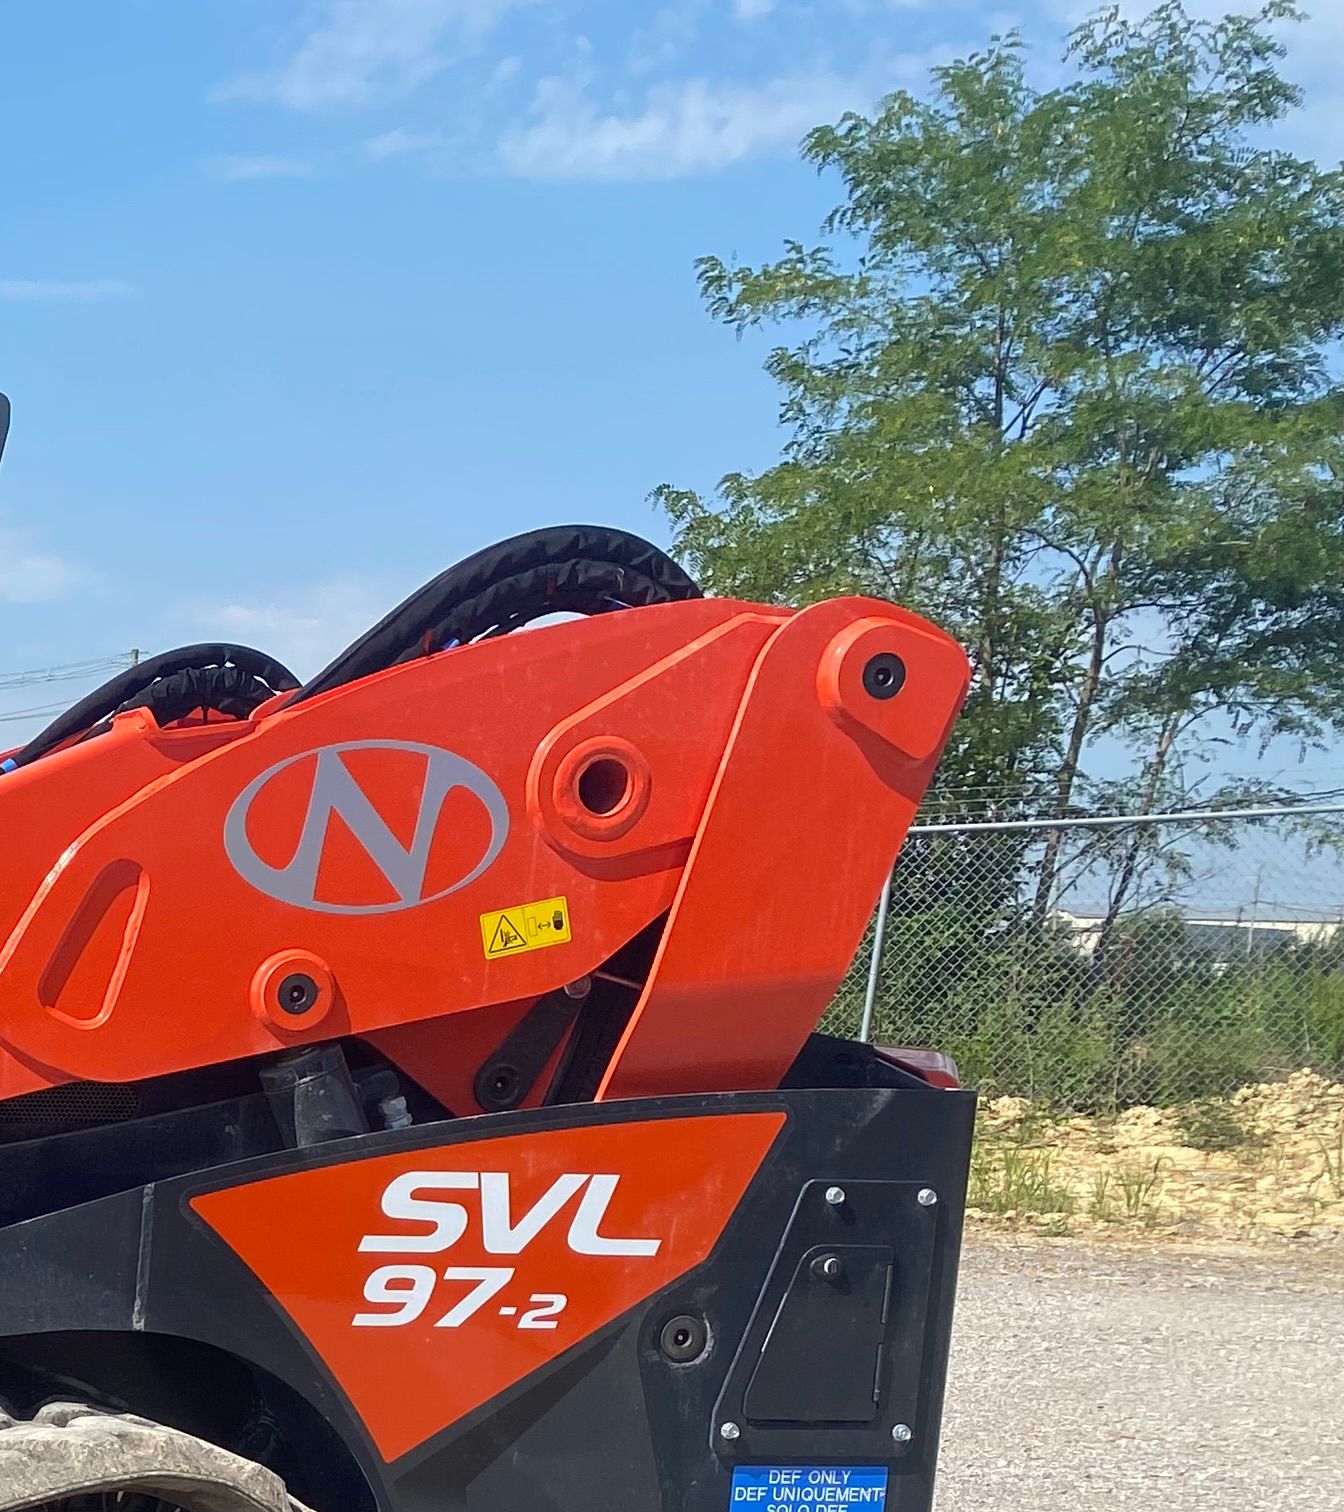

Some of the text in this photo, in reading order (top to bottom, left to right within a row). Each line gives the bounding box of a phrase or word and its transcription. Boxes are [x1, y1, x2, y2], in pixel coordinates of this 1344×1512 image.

[357, 1171, 662, 1256] SVL
[351, 1265, 568, 1329] 97-2
[735, 1487, 881, 1502] DEF UNIQUEMENT
[769, 1470, 851, 1484] DEF ONLY
